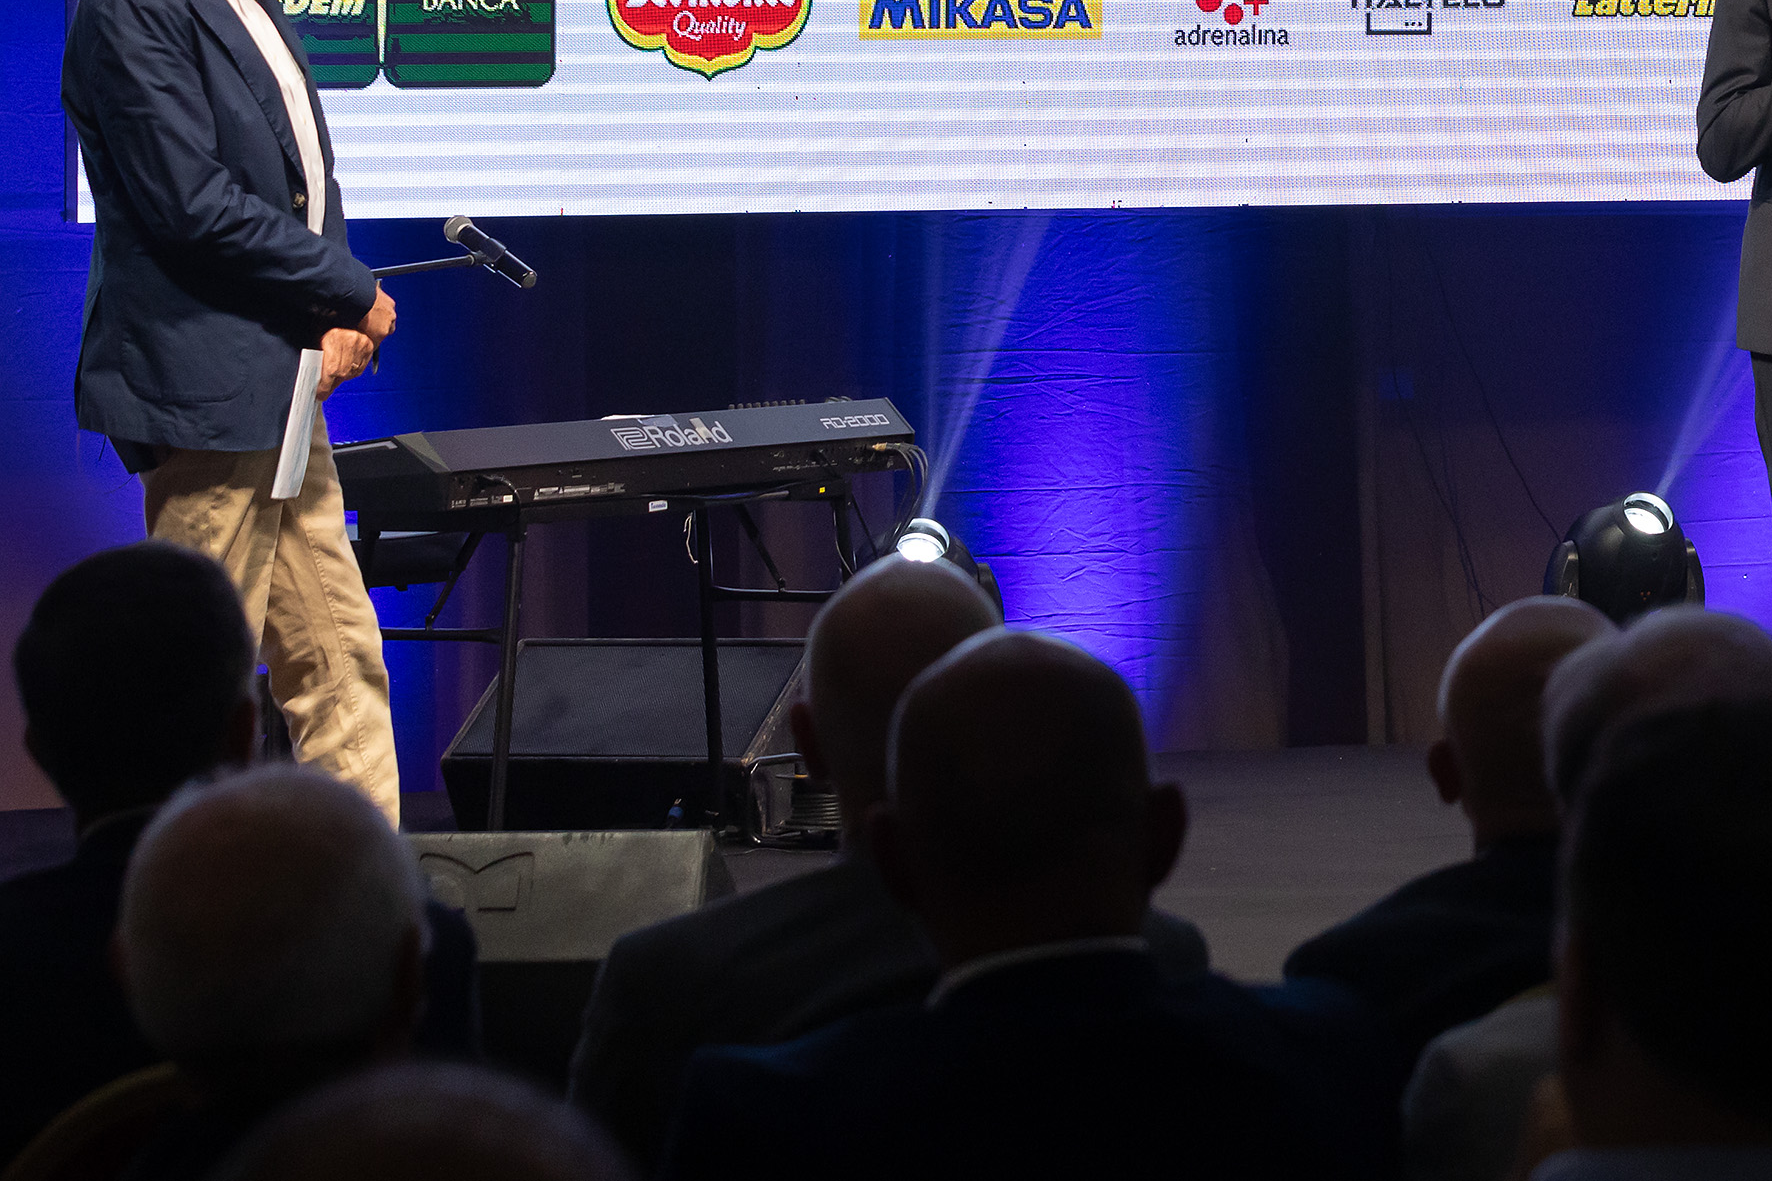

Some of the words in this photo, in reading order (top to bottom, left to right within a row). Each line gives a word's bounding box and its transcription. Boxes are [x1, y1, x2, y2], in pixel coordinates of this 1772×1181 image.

[672, 10, 747, 42] Quality
[1174, 23, 1289, 47] adrenalina
[819, 413, 890, 430] RD-2000
